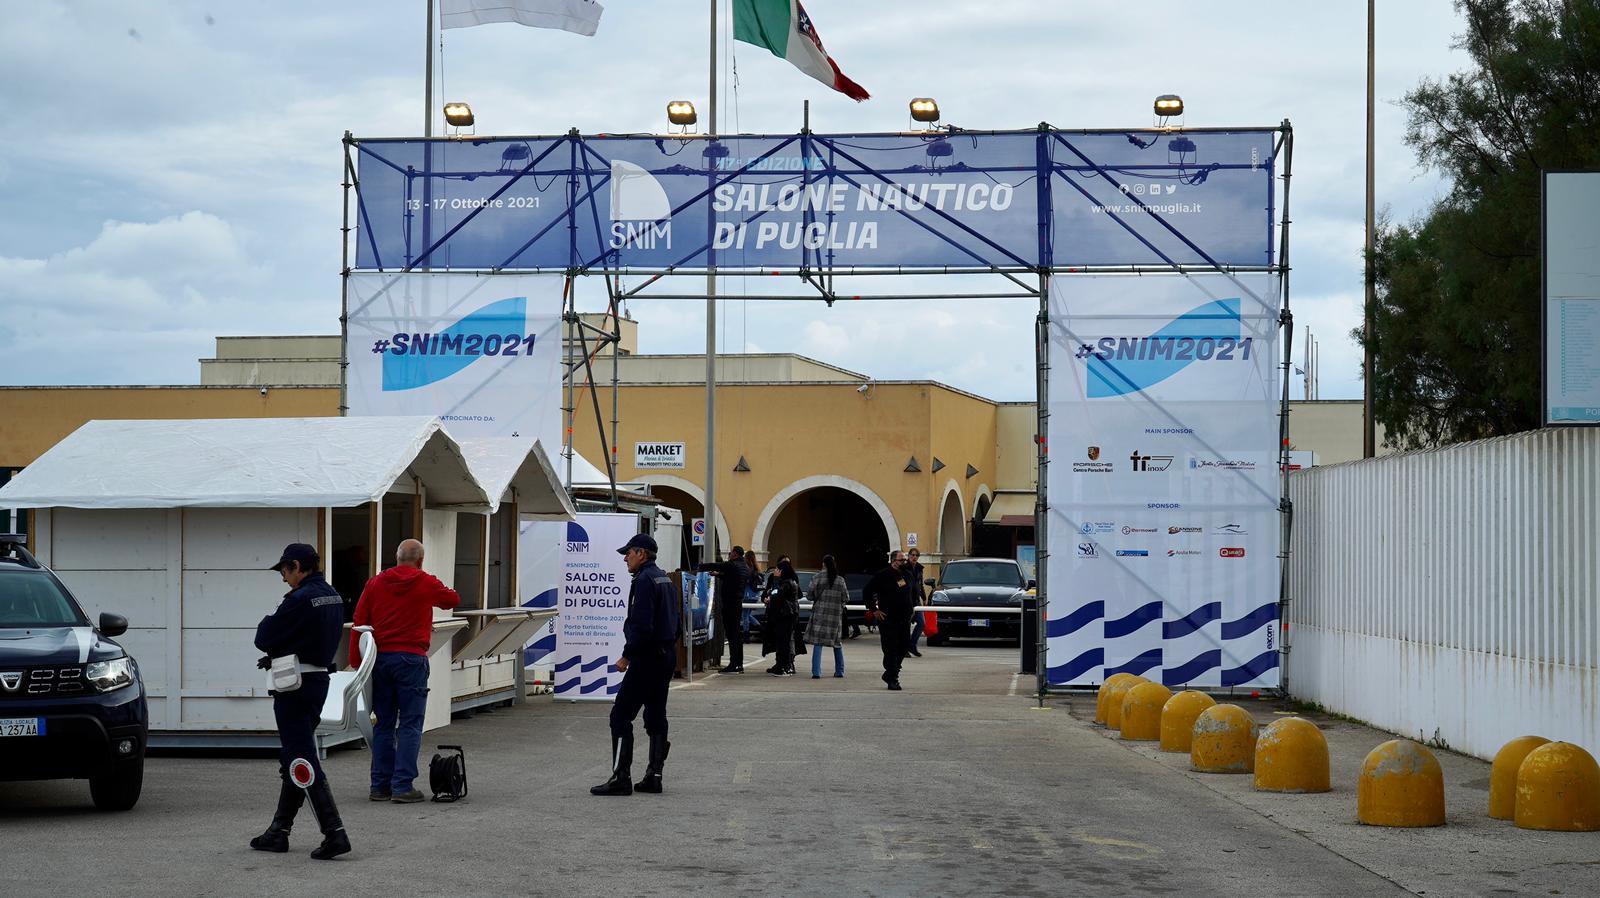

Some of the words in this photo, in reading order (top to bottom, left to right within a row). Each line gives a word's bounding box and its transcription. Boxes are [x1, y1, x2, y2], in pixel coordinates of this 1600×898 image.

[746, 157, 825, 171] EDIZIONE
[407, 199, 420, 210] 13
[433, 199, 448, 210] 17
[451, 197, 503, 209] Ottobre
[507, 197, 540, 208] 2021
[712, 183, 849, 212] SALONE
[856, 183, 1014, 212] NAUTICO
[1091, 203, 1202, 215] www.snimpuglia.it
[609, 222, 672, 250] SNIM
[712, 222, 747, 250] DI
[756, 221, 878, 250] PUGLIA
[372, 332, 536, 356] #SNIM2021
[1075, 337, 1253, 361] #SNIM2021
[637, 445, 682, 455] MARKET
[566, 542, 589, 553] SNIM
[565, 572, 615, 582] SALONE
[565, 585, 621, 595] NAUTICO
[564, 598, 577, 608] DI
[581, 598, 626, 609] PUGLIA
